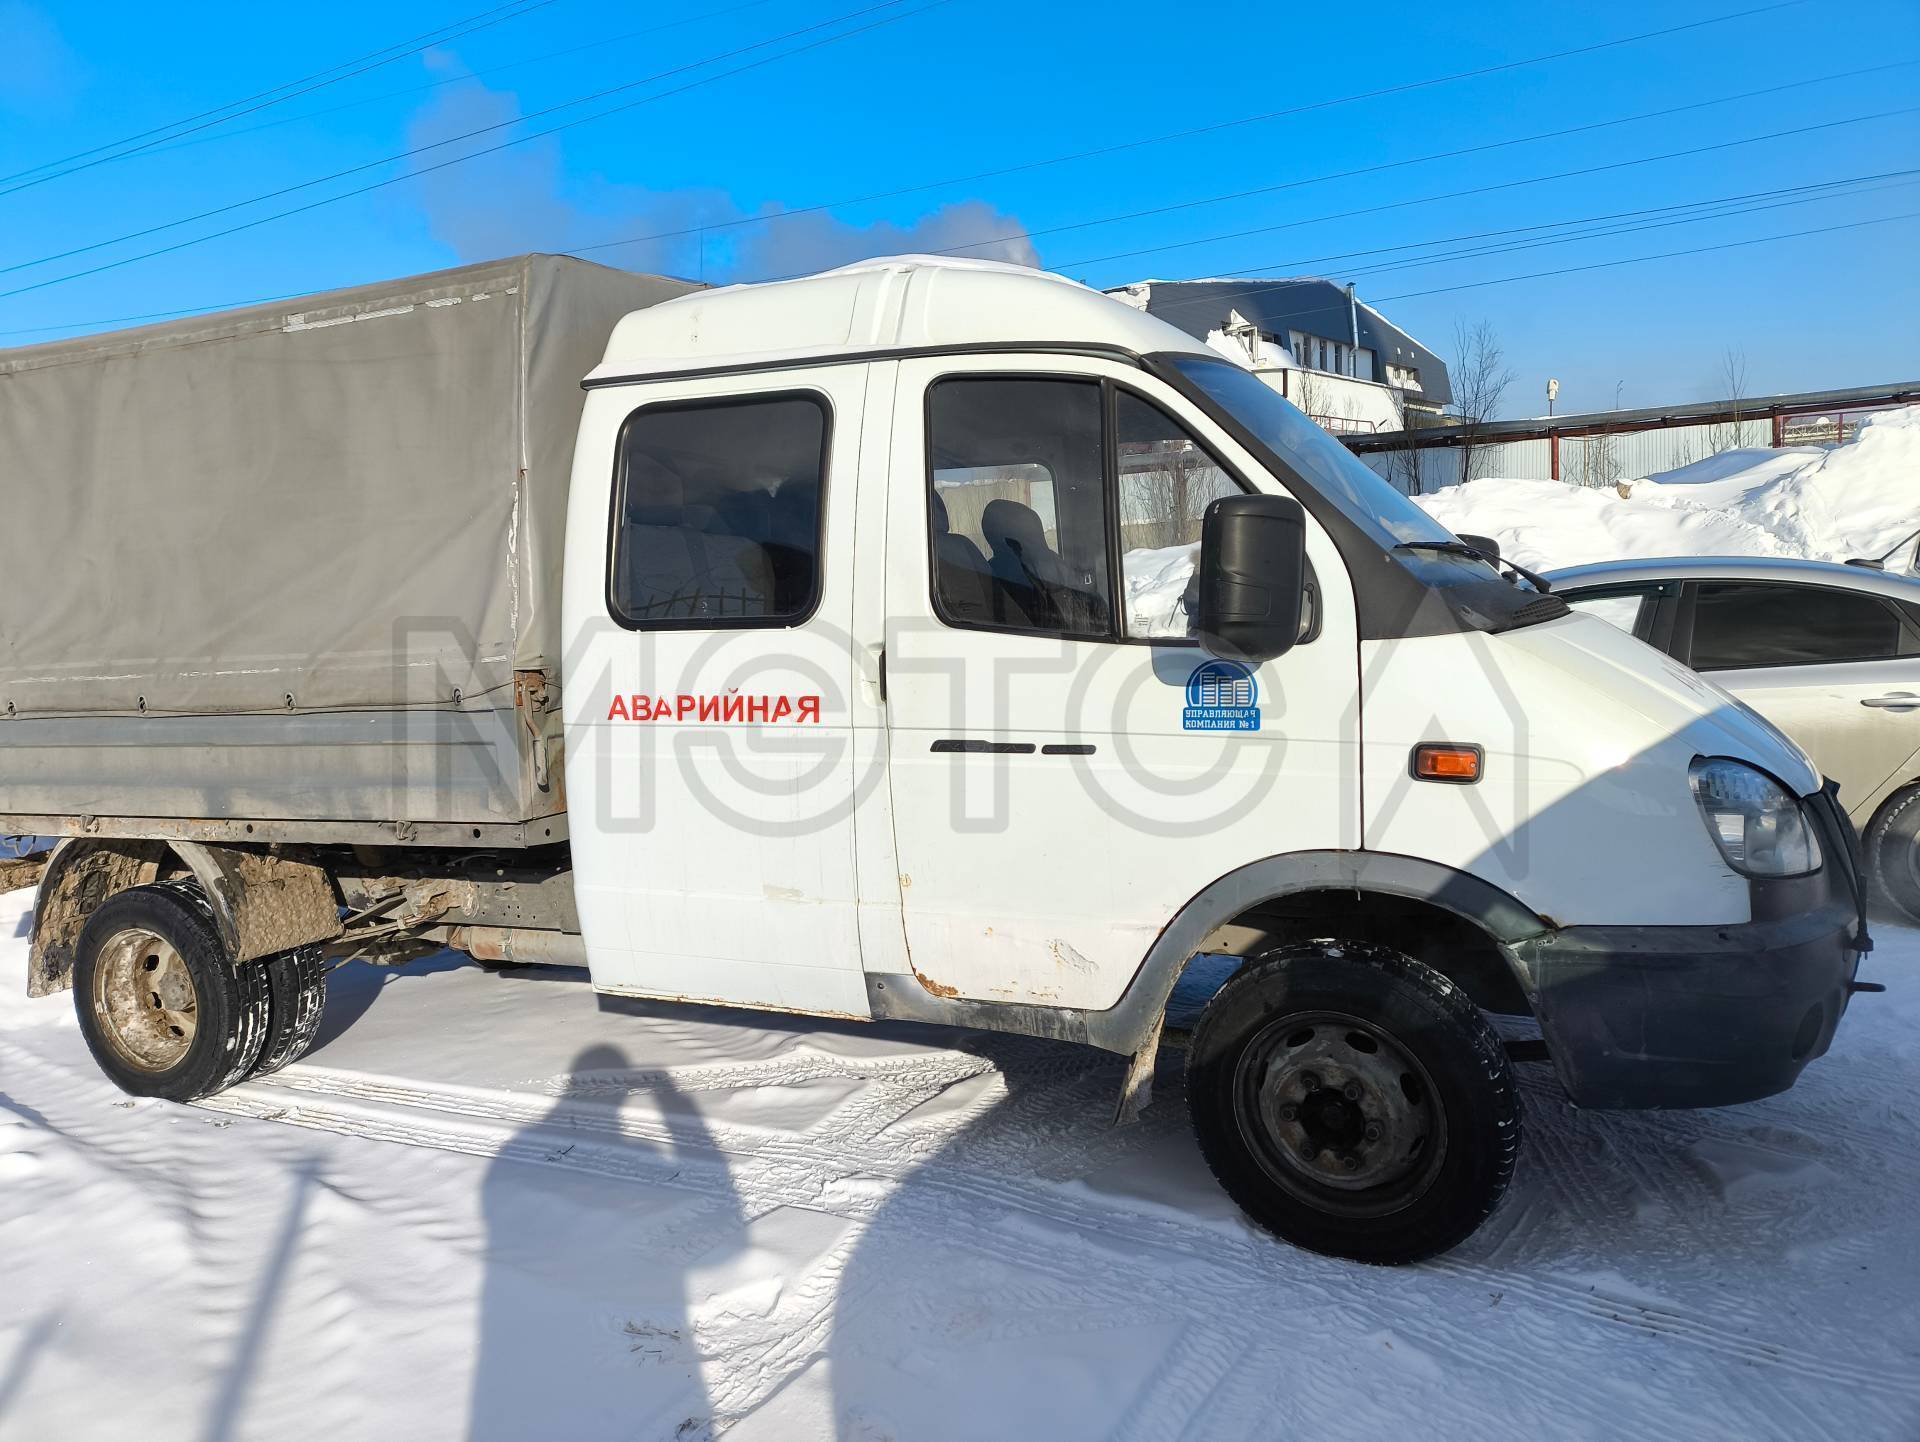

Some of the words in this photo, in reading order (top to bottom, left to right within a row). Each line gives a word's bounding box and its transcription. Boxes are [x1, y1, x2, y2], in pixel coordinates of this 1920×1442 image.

[607, 687, 820, 723] АВАРИЙНАЯ
[1185, 709, 1256, 718] УПРАВЛЯЮЩАЯ
[1185, 719, 1236, 728] КОМПАНИЯ
